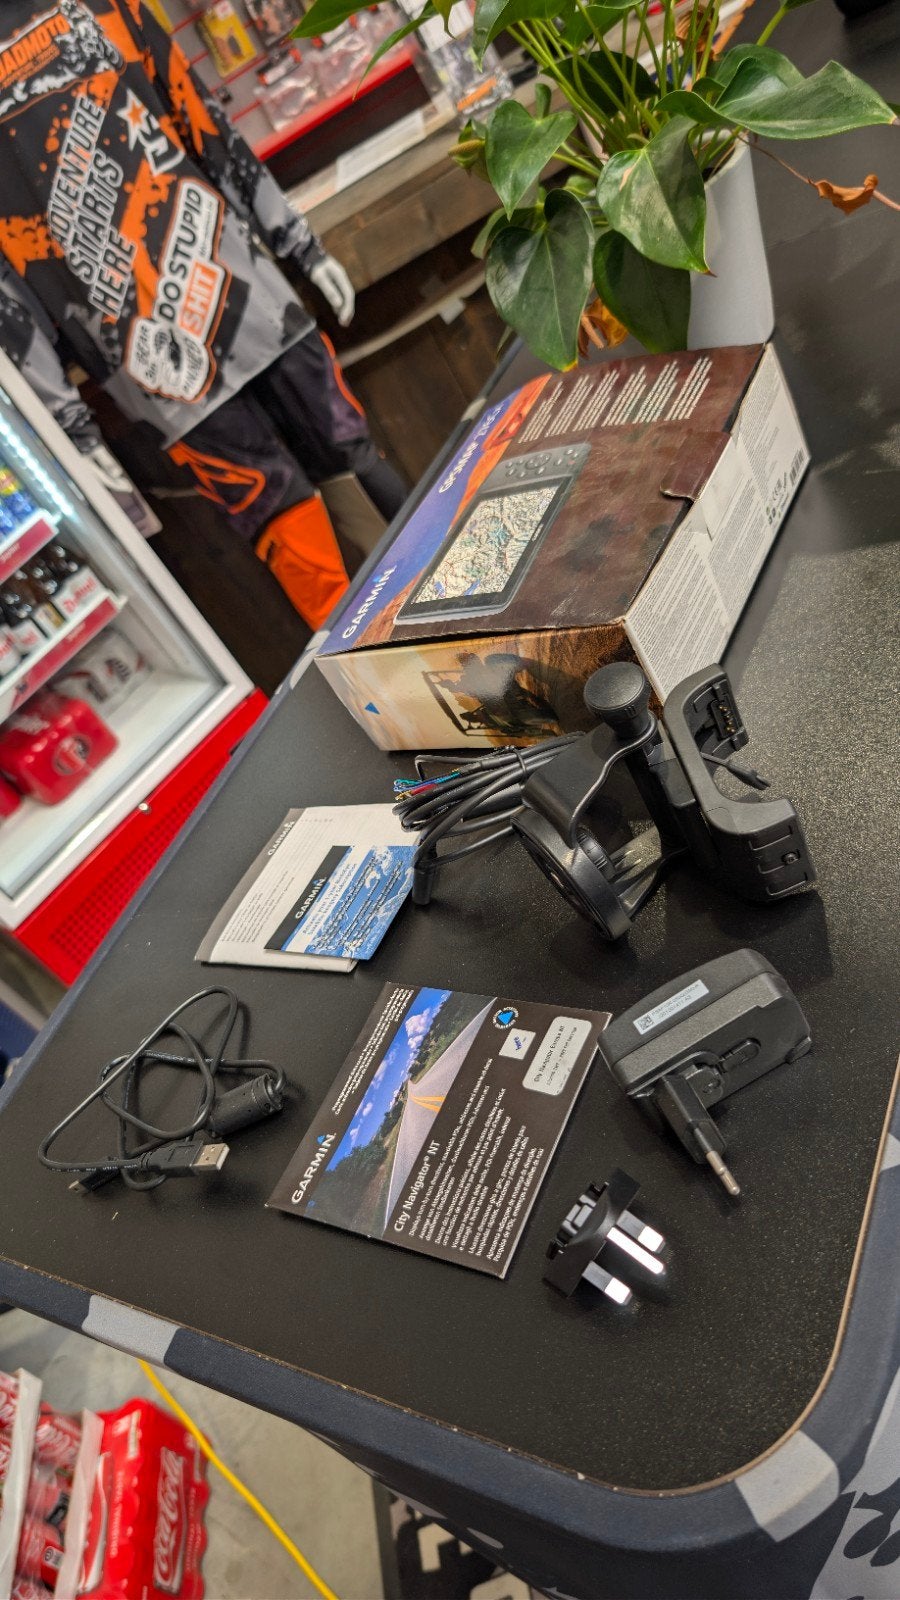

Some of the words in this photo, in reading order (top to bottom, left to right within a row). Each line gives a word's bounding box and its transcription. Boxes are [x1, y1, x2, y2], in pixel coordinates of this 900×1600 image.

[49, 93, 106, 246] ADVENTURE
[66, 149, 124, 285] STARTS
[169, 188, 202, 280] STUPID
[89, 224, 137, 320] HERE
[159, 281, 182, 324] DO
[181, 263, 218, 337] SHIT
[342, 565, 396, 639] GARMIN
[294, 876, 326, 920] GARMIN
[291, 1133, 336, 1204] GARMIN
[394, 1211, 410, 1232] City
[427, 1140, 440, 1155] NT
